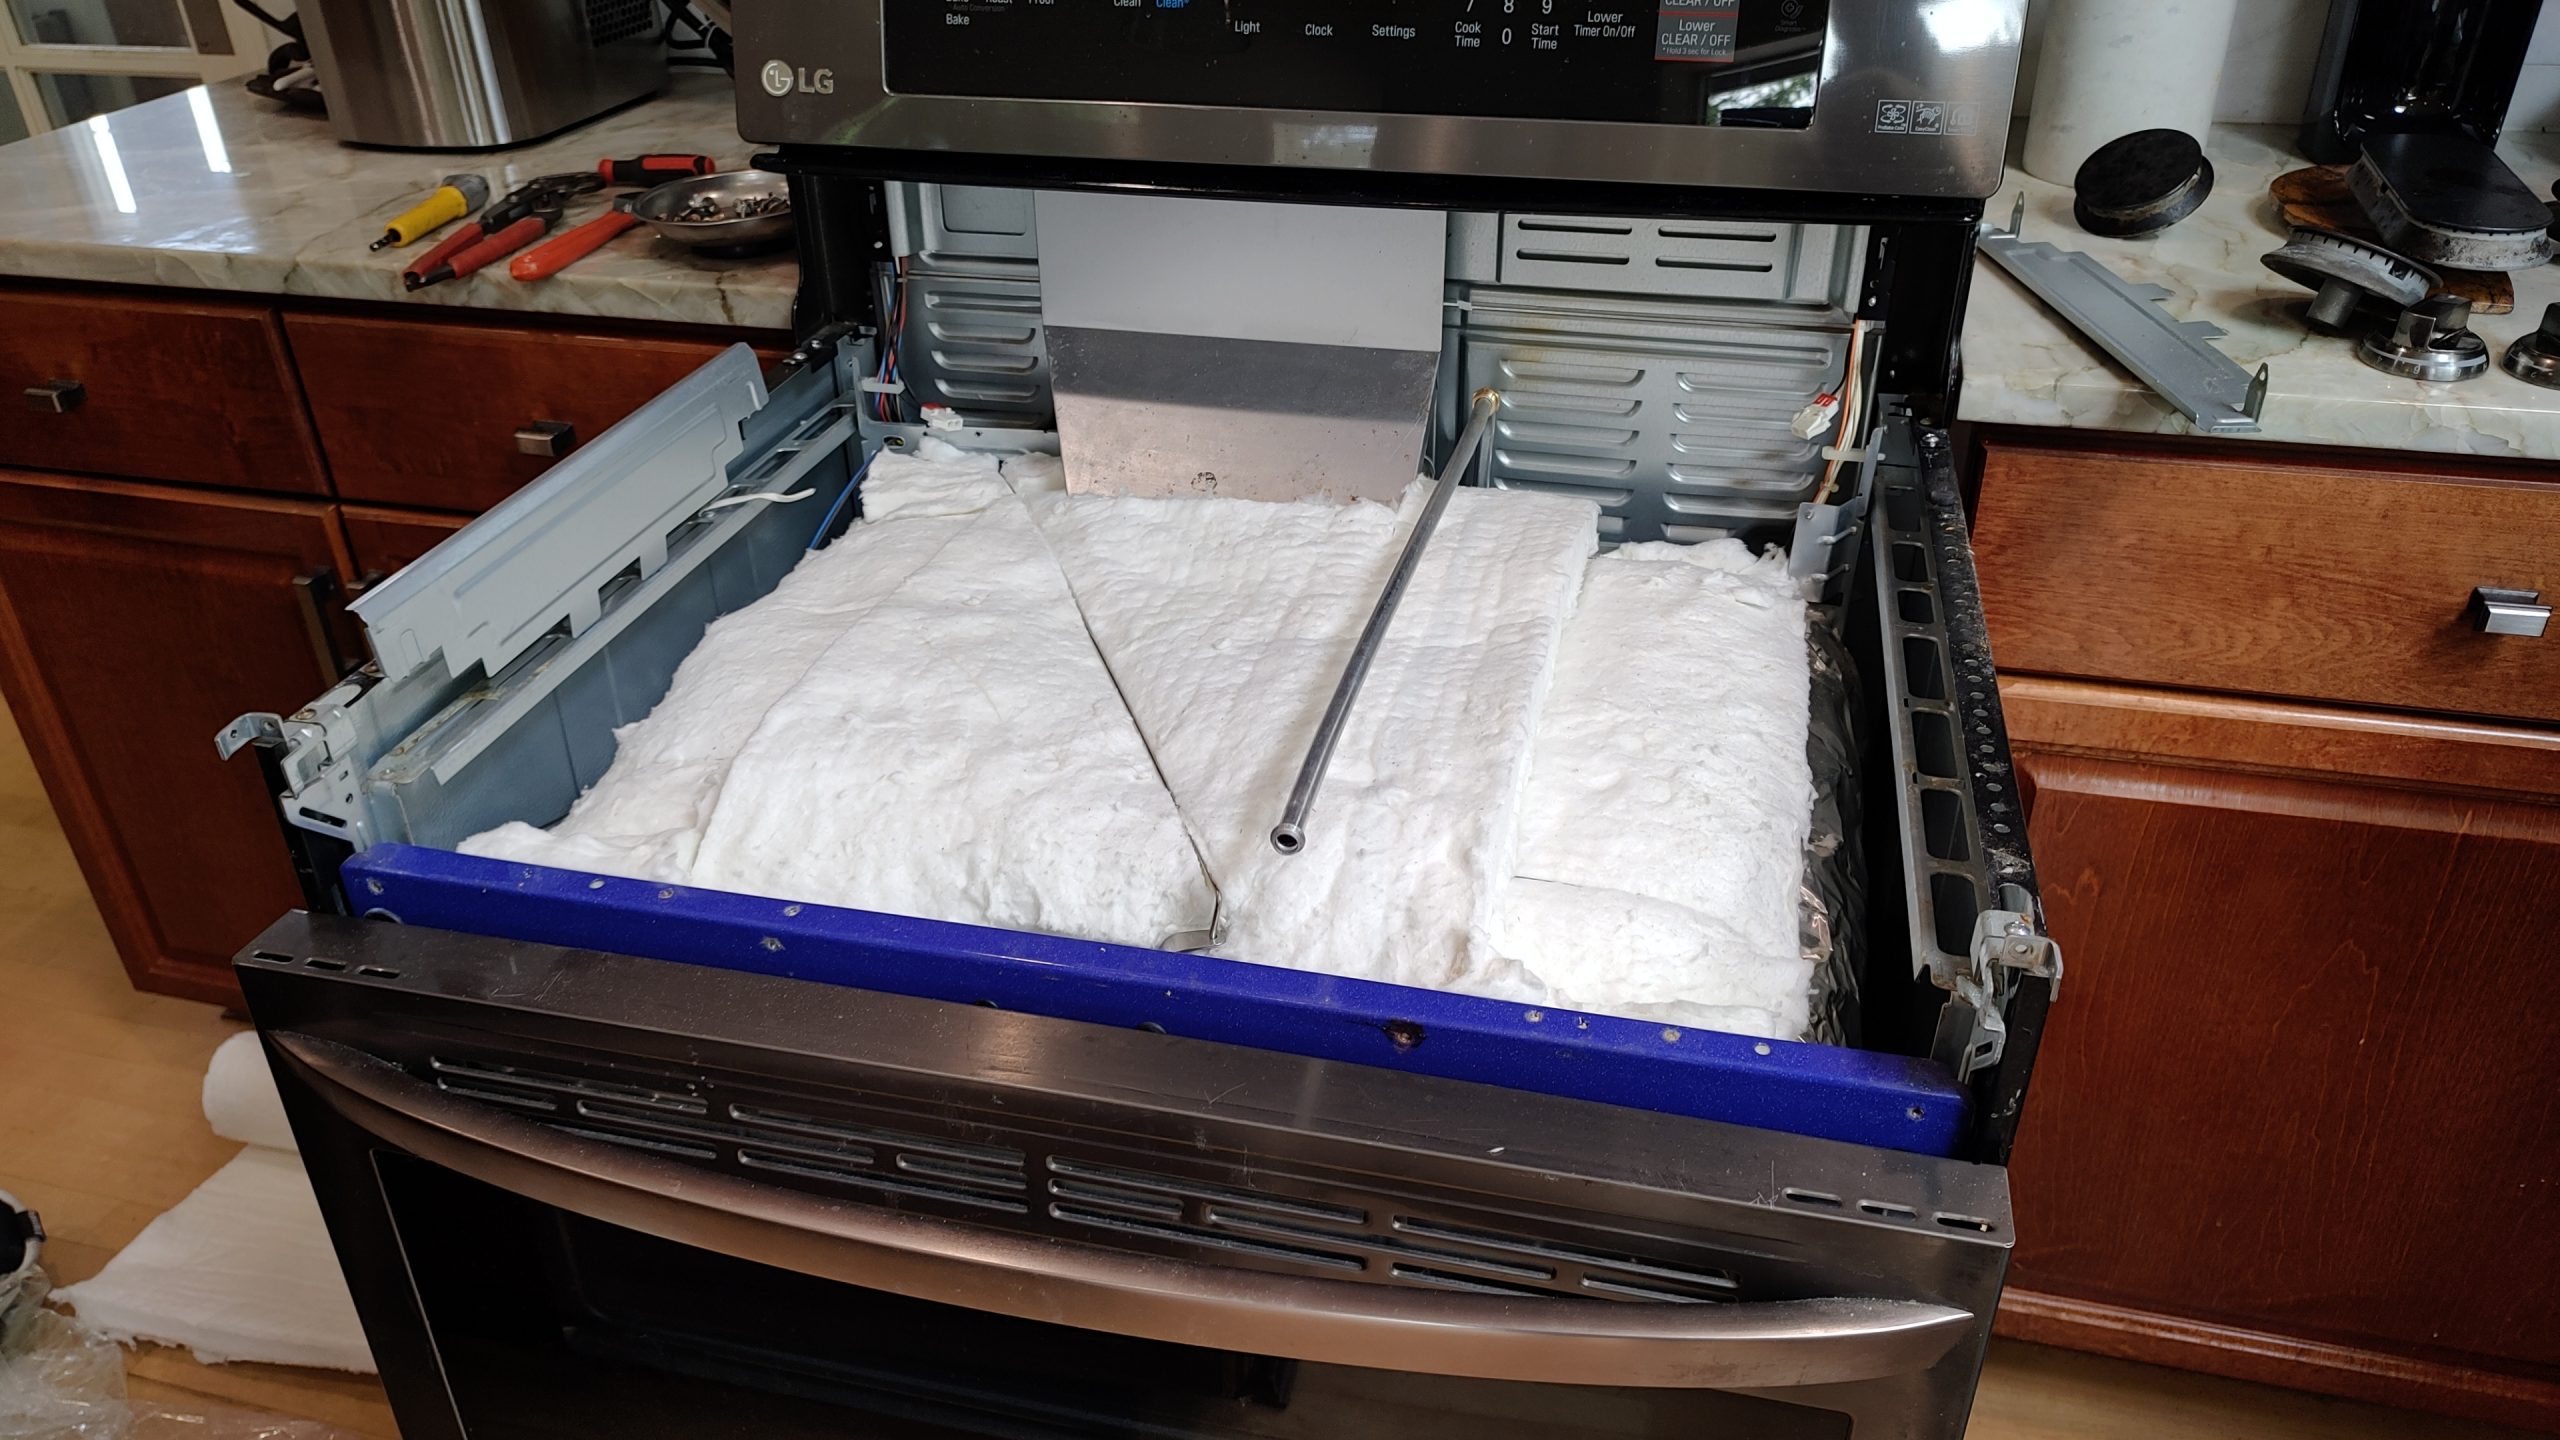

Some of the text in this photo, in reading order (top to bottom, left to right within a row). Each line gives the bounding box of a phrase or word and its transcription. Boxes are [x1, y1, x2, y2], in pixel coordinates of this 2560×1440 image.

[1541, 0, 1552, 14] 9
[945, 13, 970, 25] Bake
[1587, 11, 1623, 23] Lower
[1234, 20, 1261, 34] Light
[1305, 23, 1333, 36] Clock
[1371, 24, 1416, 39] Settings
[1454, 21, 1482, 34] Cook
[1531, 23, 1560, 36] Start
[1573, 24, 1636, 38] Timer On/Off
[1679, 19, 1716, 31] Lower
[1454, 35, 1481, 48] Time
[1501, 28, 1512, 45] 0
[1661, 33, 1698, 46] CLEAR
[1709, 35, 1731, 47] OFF
[1531, 37, 1558, 50] Time
[798, 67, 834, 95] LG
